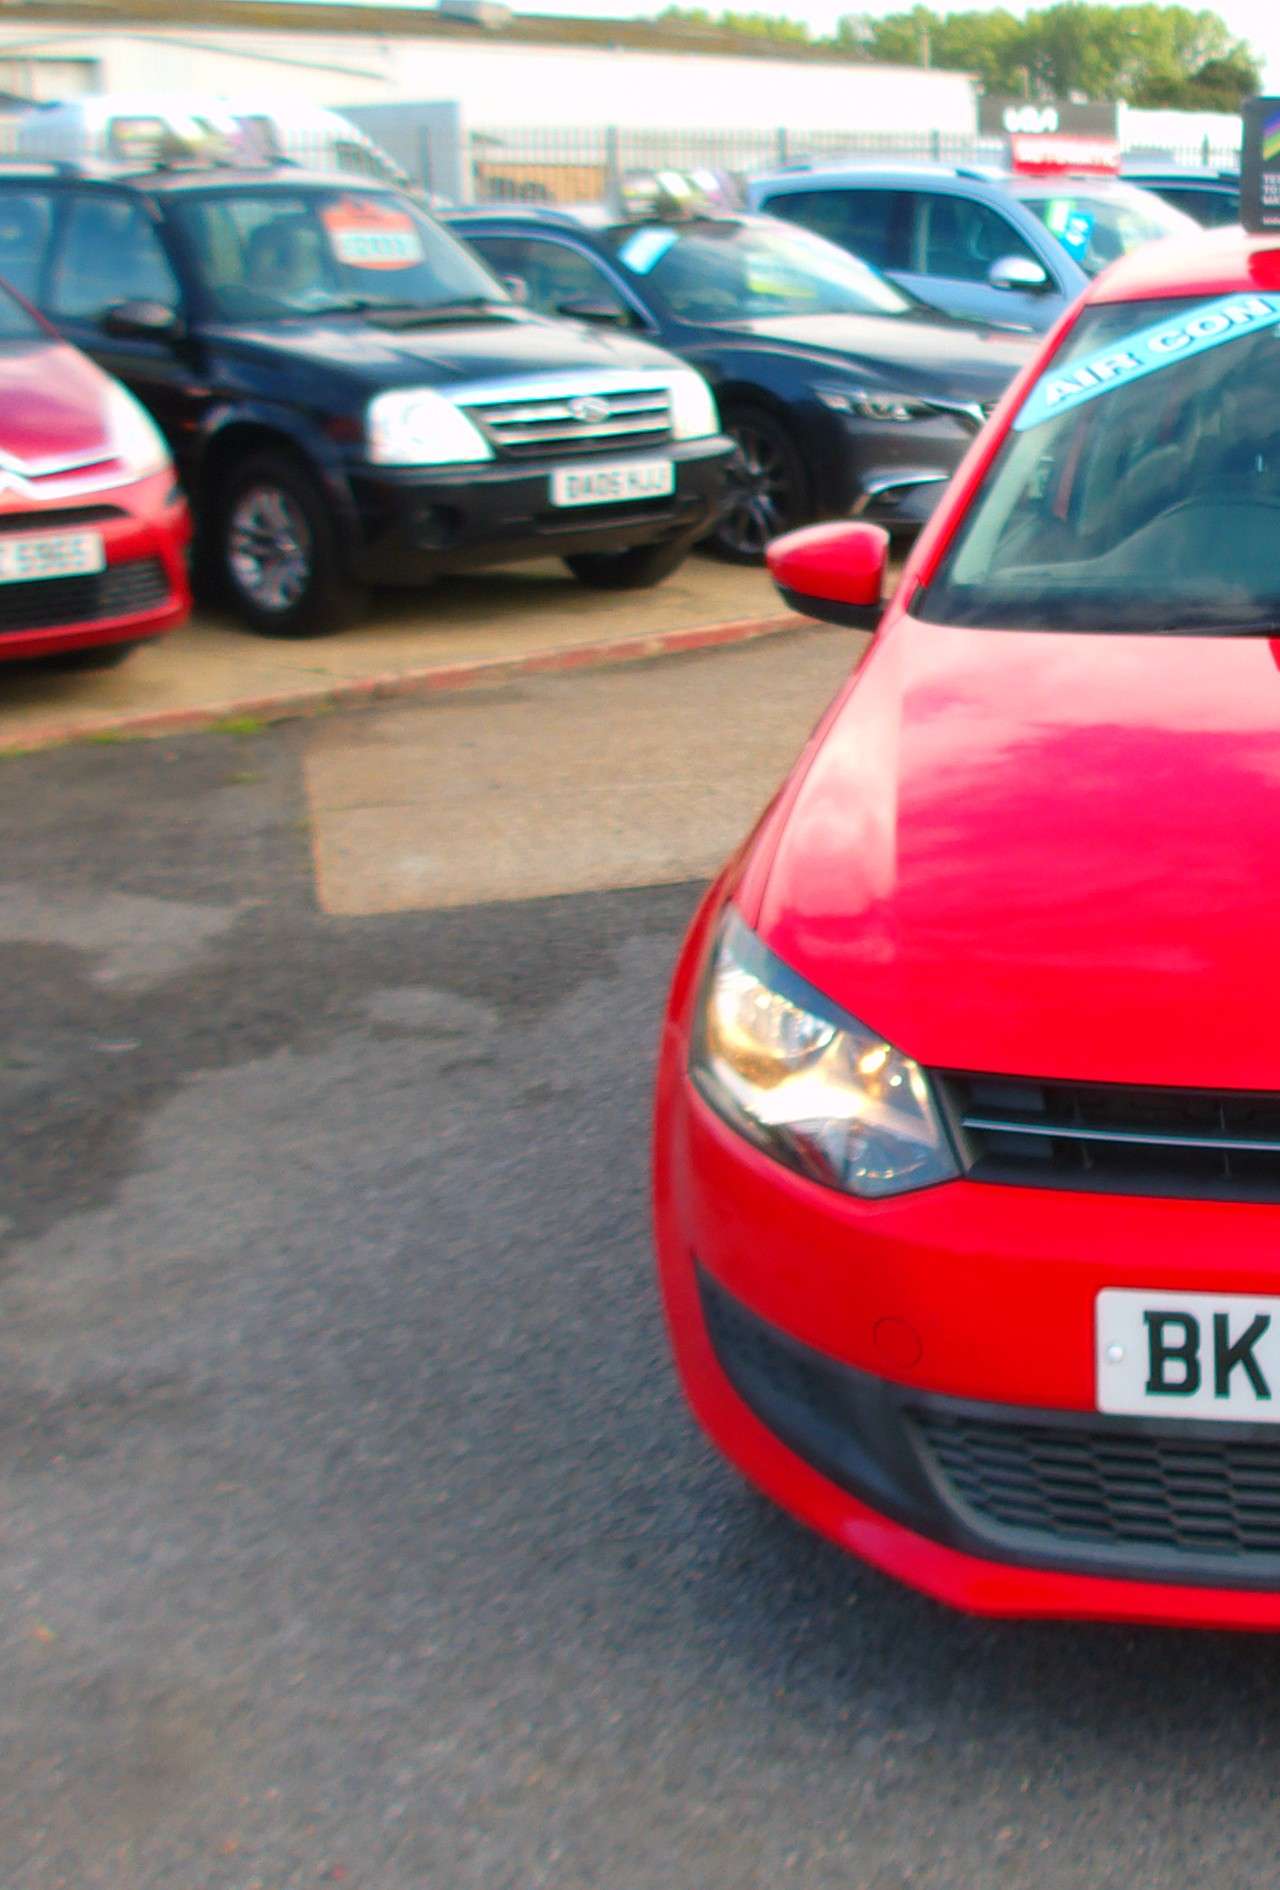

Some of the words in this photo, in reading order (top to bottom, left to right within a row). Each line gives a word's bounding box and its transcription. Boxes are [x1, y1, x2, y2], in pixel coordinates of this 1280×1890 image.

[1263, 185, 1277, 195] TO
[1045, 352, 1144, 406] AIR
[1147, 297, 1277, 352] CON
